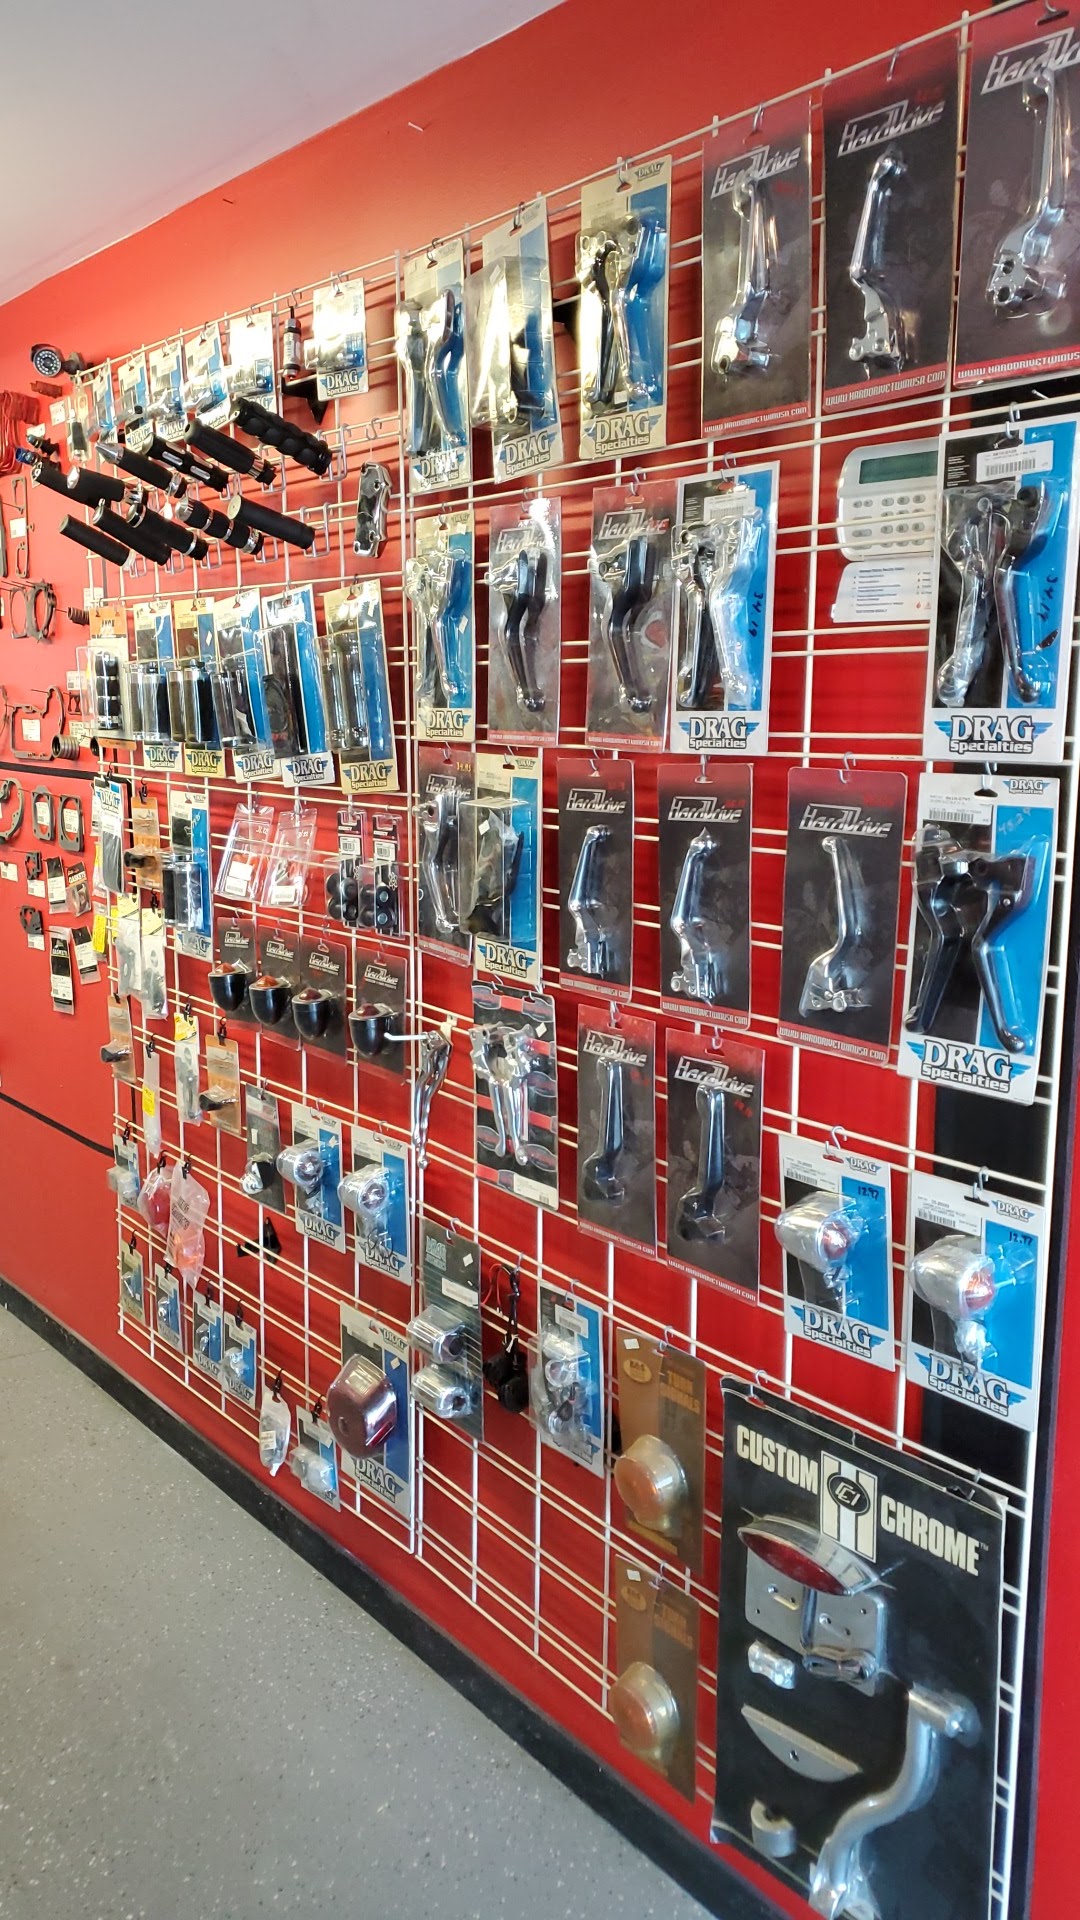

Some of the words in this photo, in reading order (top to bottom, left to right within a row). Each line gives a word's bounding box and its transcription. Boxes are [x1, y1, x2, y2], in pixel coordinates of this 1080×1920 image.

[326, 371, 358, 390] DRAG
[596, 413, 650, 444] DRAG
[506, 430, 551, 465] DRAG
[596, 435, 650, 454] Specialties
[688, 716, 748, 741] DRAG
[950, 715, 1034, 744] DRAG
[688, 737, 748, 750] Specialties
[949, 740, 1033, 754] Specialties
[191, 752, 218, 768] DRAG
[242, 752, 274, 770] DRAG
[293, 759, 323, 777] DRAG
[351, 763, 388, 784] DRAG
[1009, 779, 1043, 791] DRAG
[668, 796, 742, 823] HardDrive
[799, 803, 892, 838] HardDrive
[486, 942, 528, 970] DRAG
[486, 961, 527, 978] Specialties
[924, 1039, 1013, 1083] DRAG
[674, 1055, 755, 1098] HardDrive
[922, 1065, 1010, 1093] Specialties
[803, 1305, 871, 1348] DRAG
[803, 1326, 871, 1358] Specialties
[930, 1352, 1010, 1406] DRAG
[929, 1375, 1009, 1416] Specialties
[736, 1425, 819, 1495] CUSTOM
[357, 1457, 397, 1496] DRAG
[880, 1494, 980, 1577] CHROME
